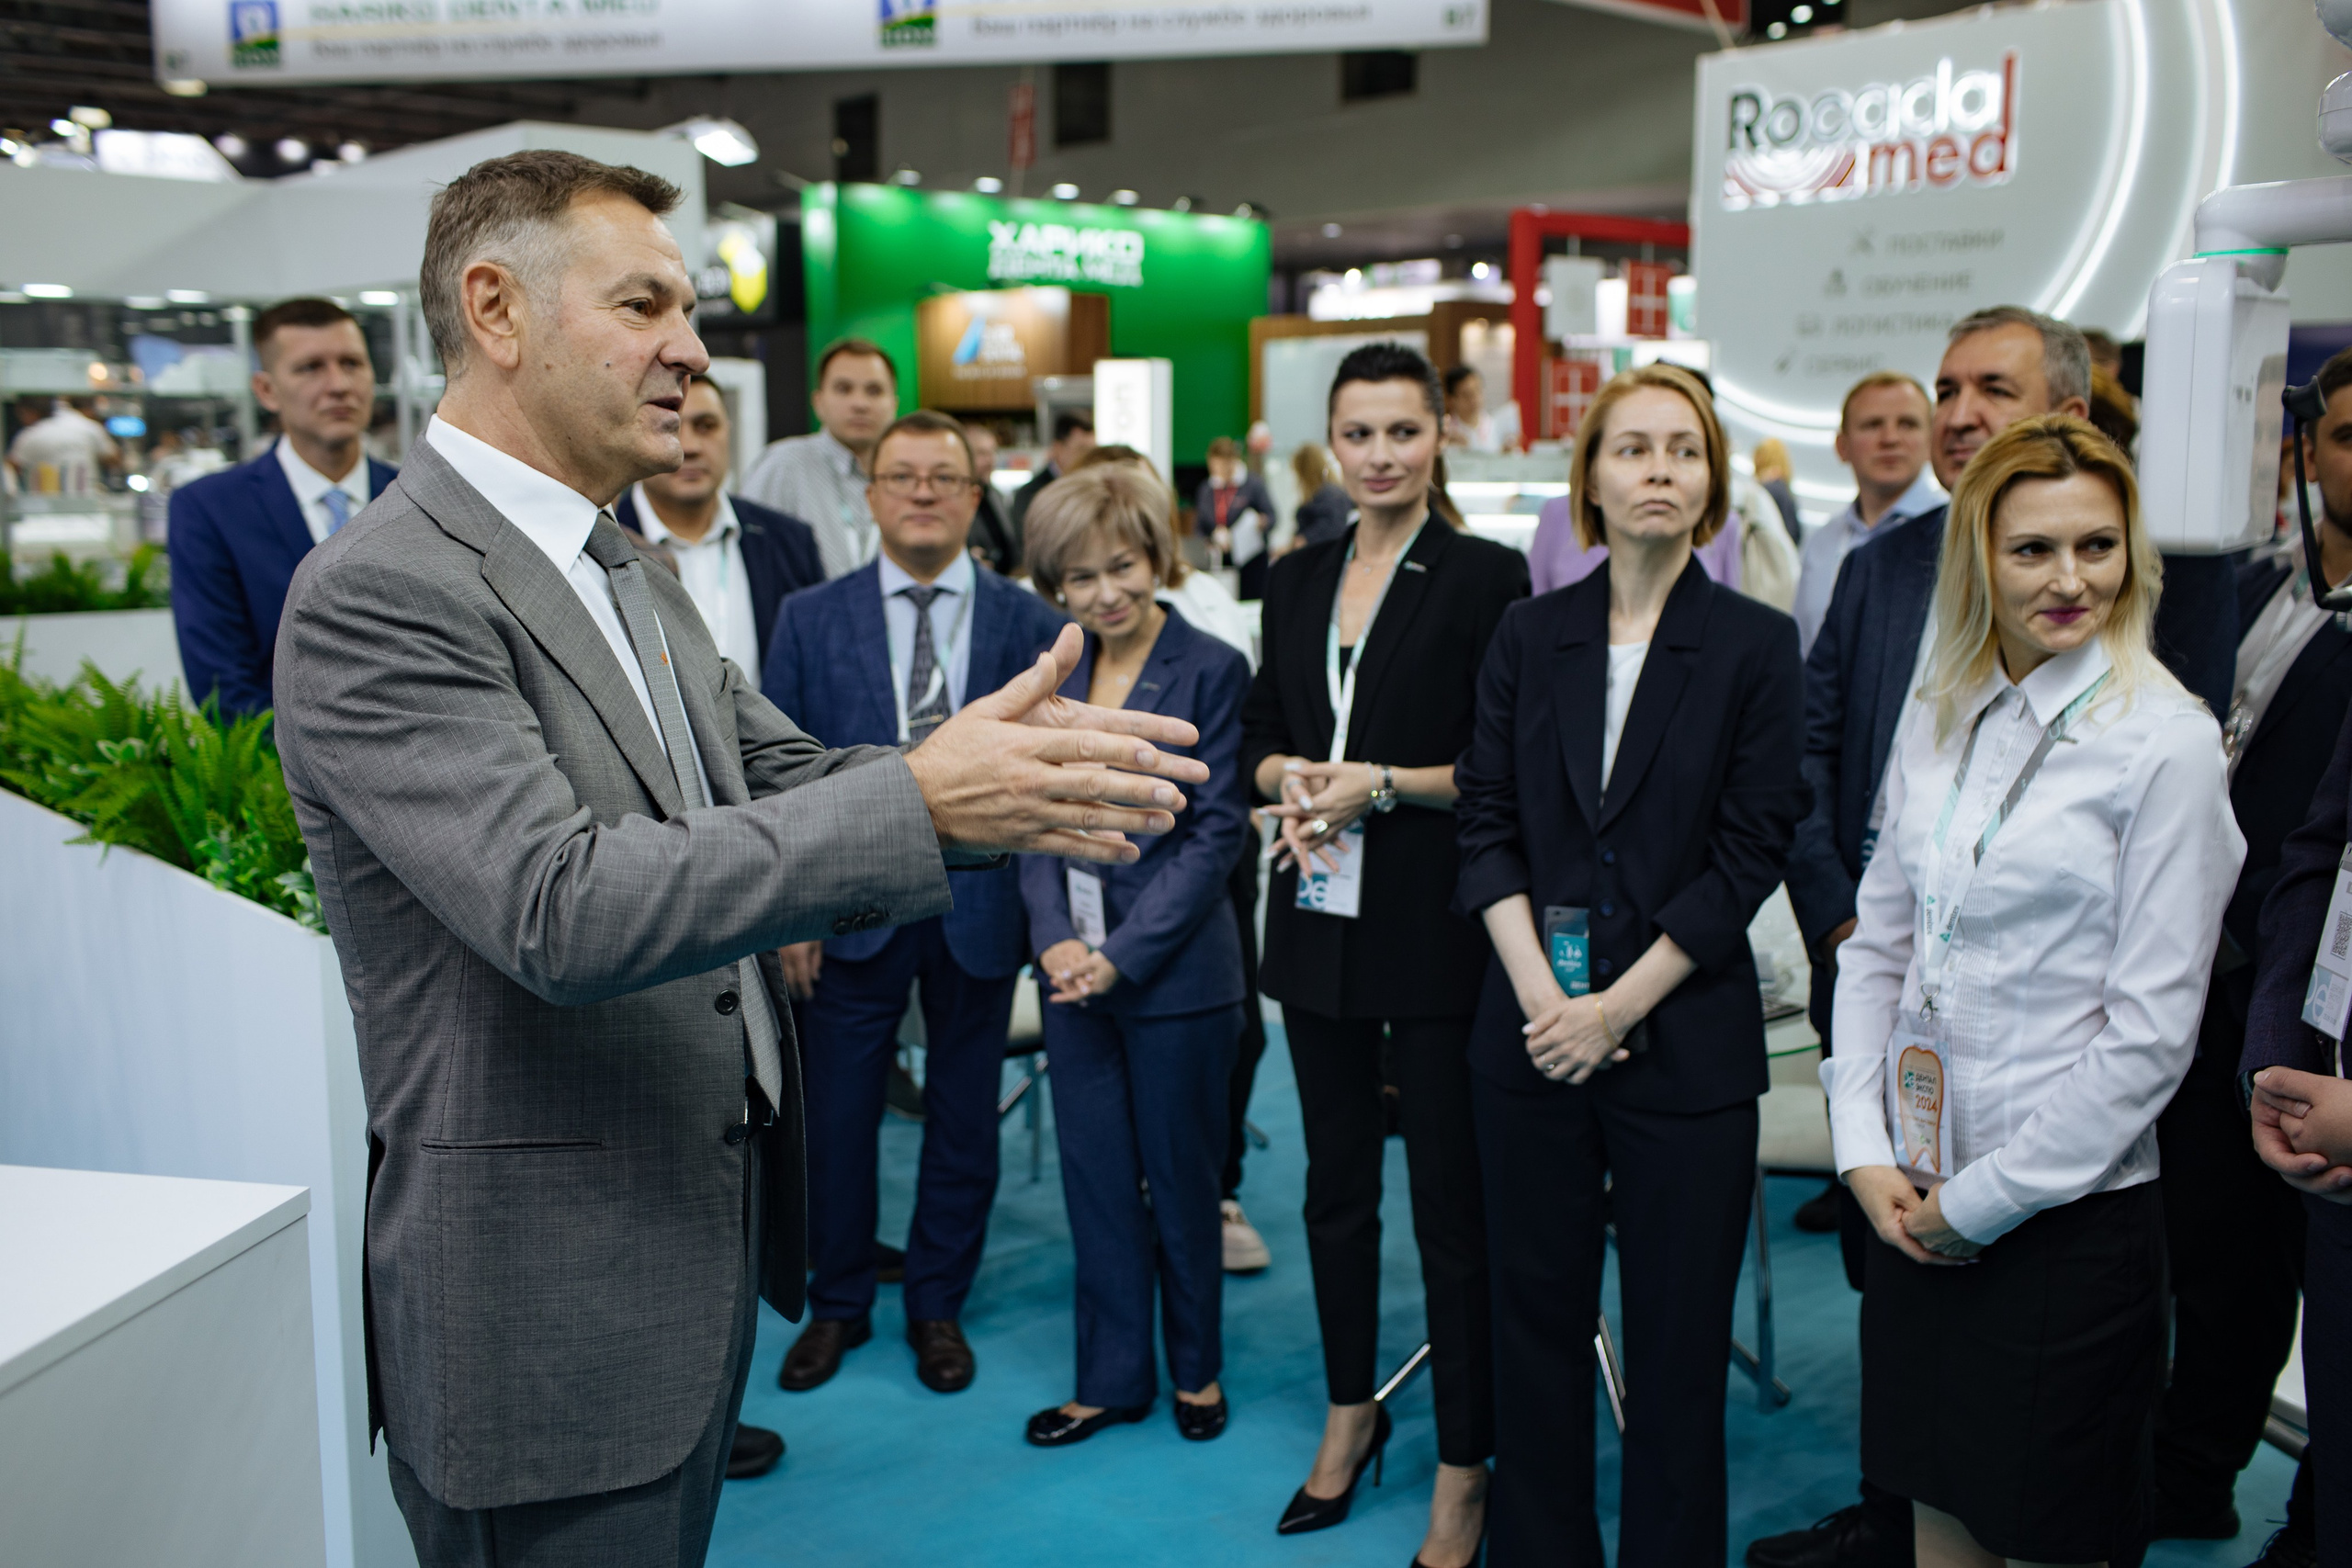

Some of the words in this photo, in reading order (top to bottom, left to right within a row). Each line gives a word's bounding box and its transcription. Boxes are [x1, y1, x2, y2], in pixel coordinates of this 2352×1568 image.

[1886, 230, 2004, 256] ПОСТАВКИ
[1860, 271, 1973, 298] ОБУЧЕНИЕ
[1916, 1083, 1935, 1095] ЭКСПО
[1915, 1093, 1938, 1112] 2024
